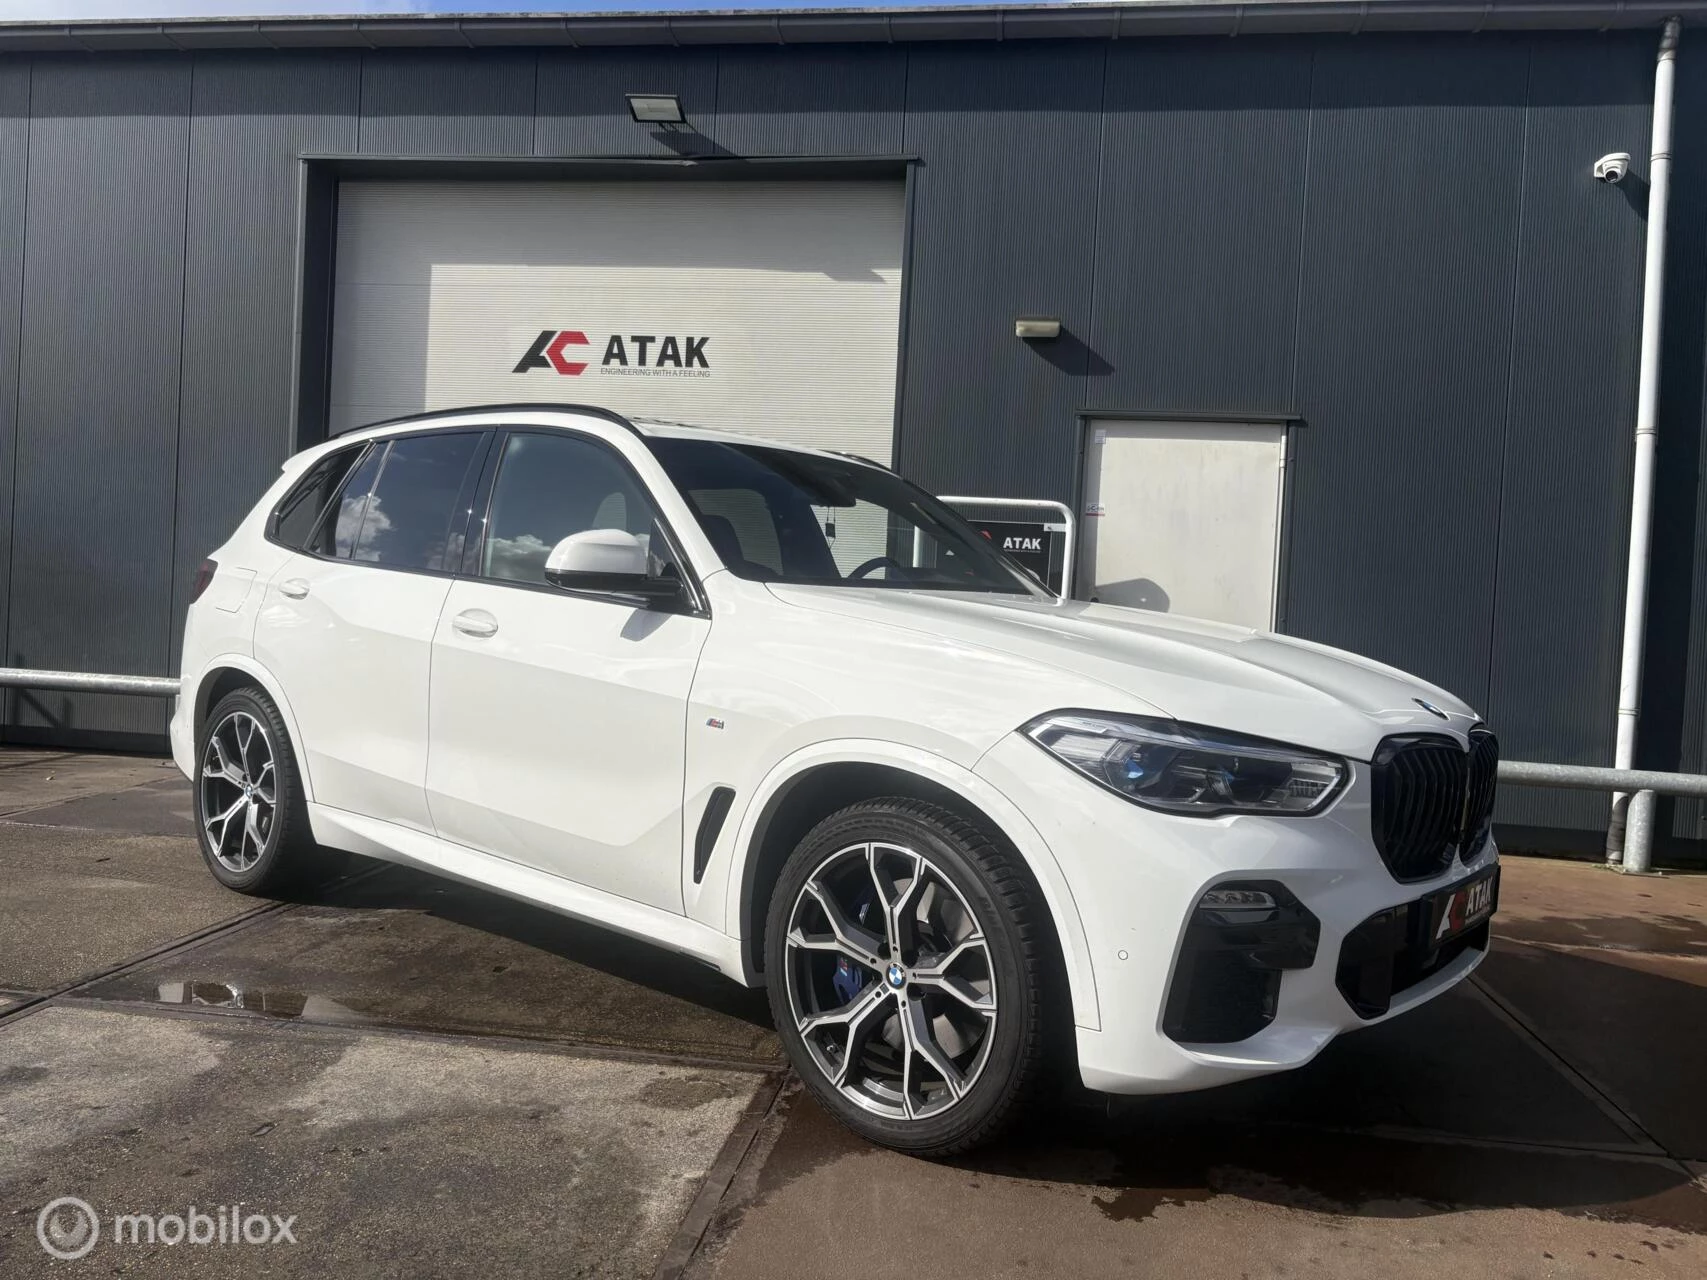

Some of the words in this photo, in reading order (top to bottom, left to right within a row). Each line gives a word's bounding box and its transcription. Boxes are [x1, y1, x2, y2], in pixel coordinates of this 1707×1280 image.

[601, 335, 710, 369] ATAK
[600, 367, 651, 377] ENGINEERING
[652, 368, 672, 377] WITH
[679, 370, 711, 378] FEELING
[1003, 536, 1041, 550] ATAK
[1465, 876, 1493, 917] ATAK
